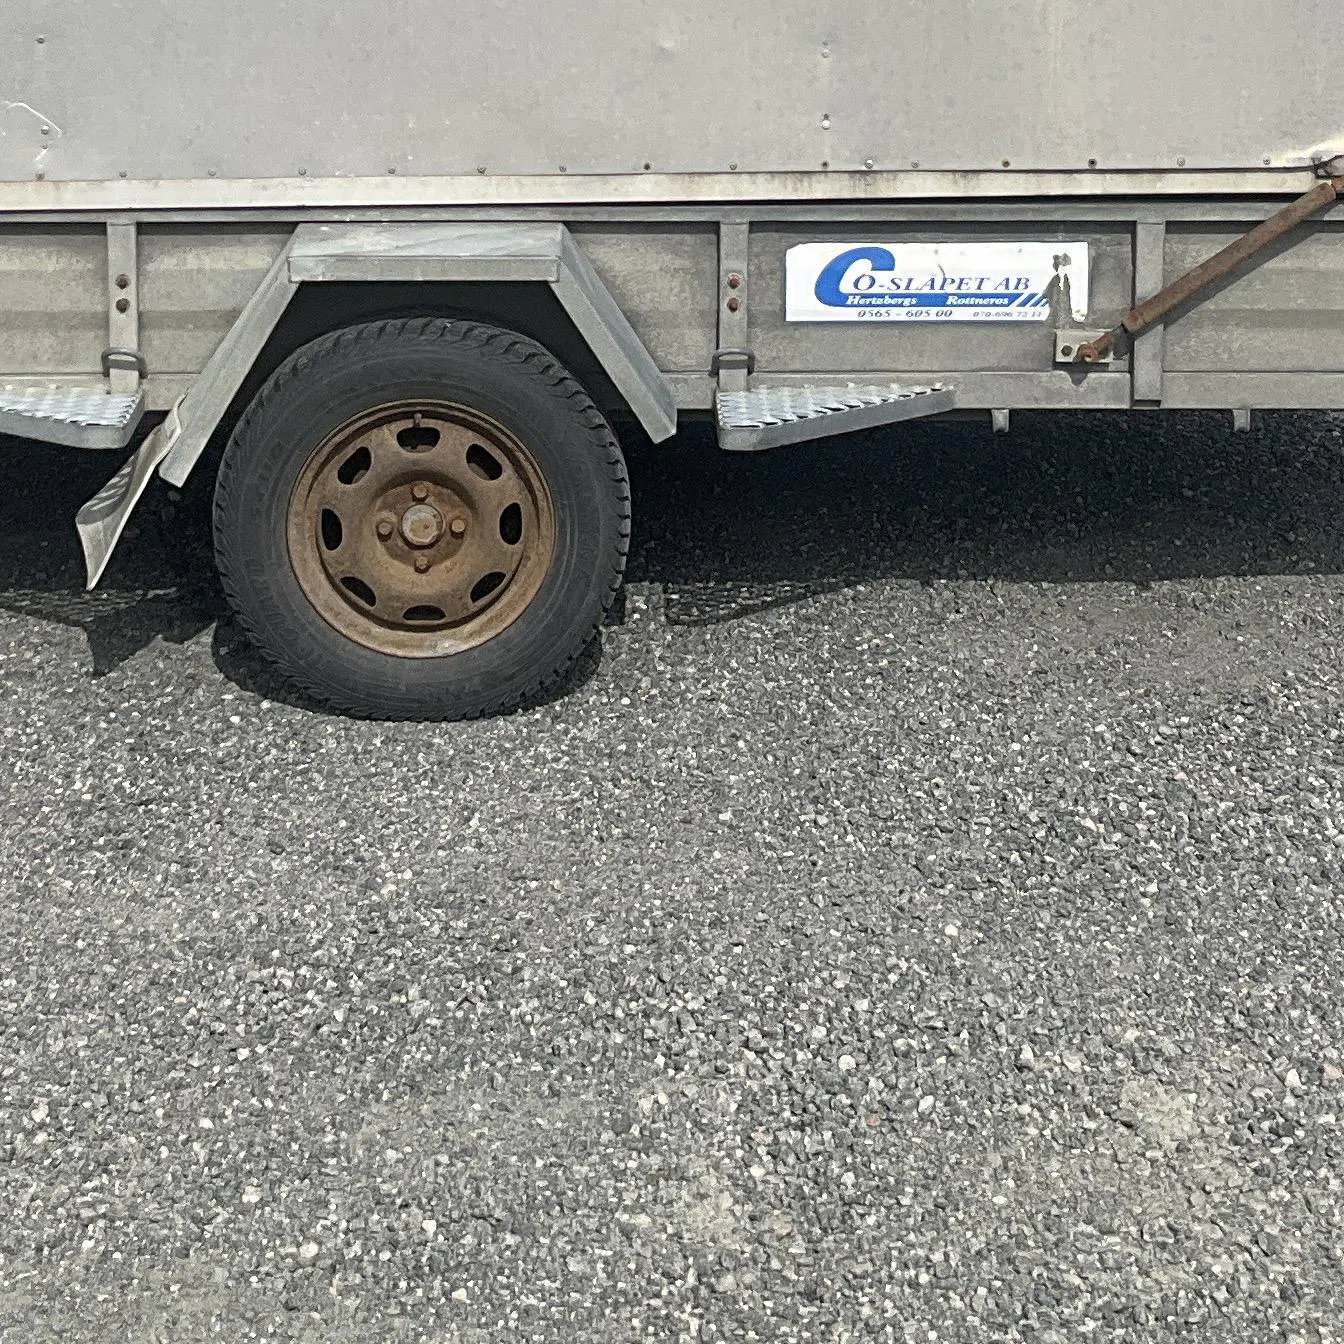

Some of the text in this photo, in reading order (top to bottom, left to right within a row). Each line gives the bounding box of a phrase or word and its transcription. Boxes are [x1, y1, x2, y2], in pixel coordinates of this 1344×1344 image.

[994, 277, 1030, 291] AB
[946, 295, 1010, 305] Rottneros
[857, 309, 892, 318] 0565
[905, 309, 931, 318] 605
[935, 309, 954, 318] 00
